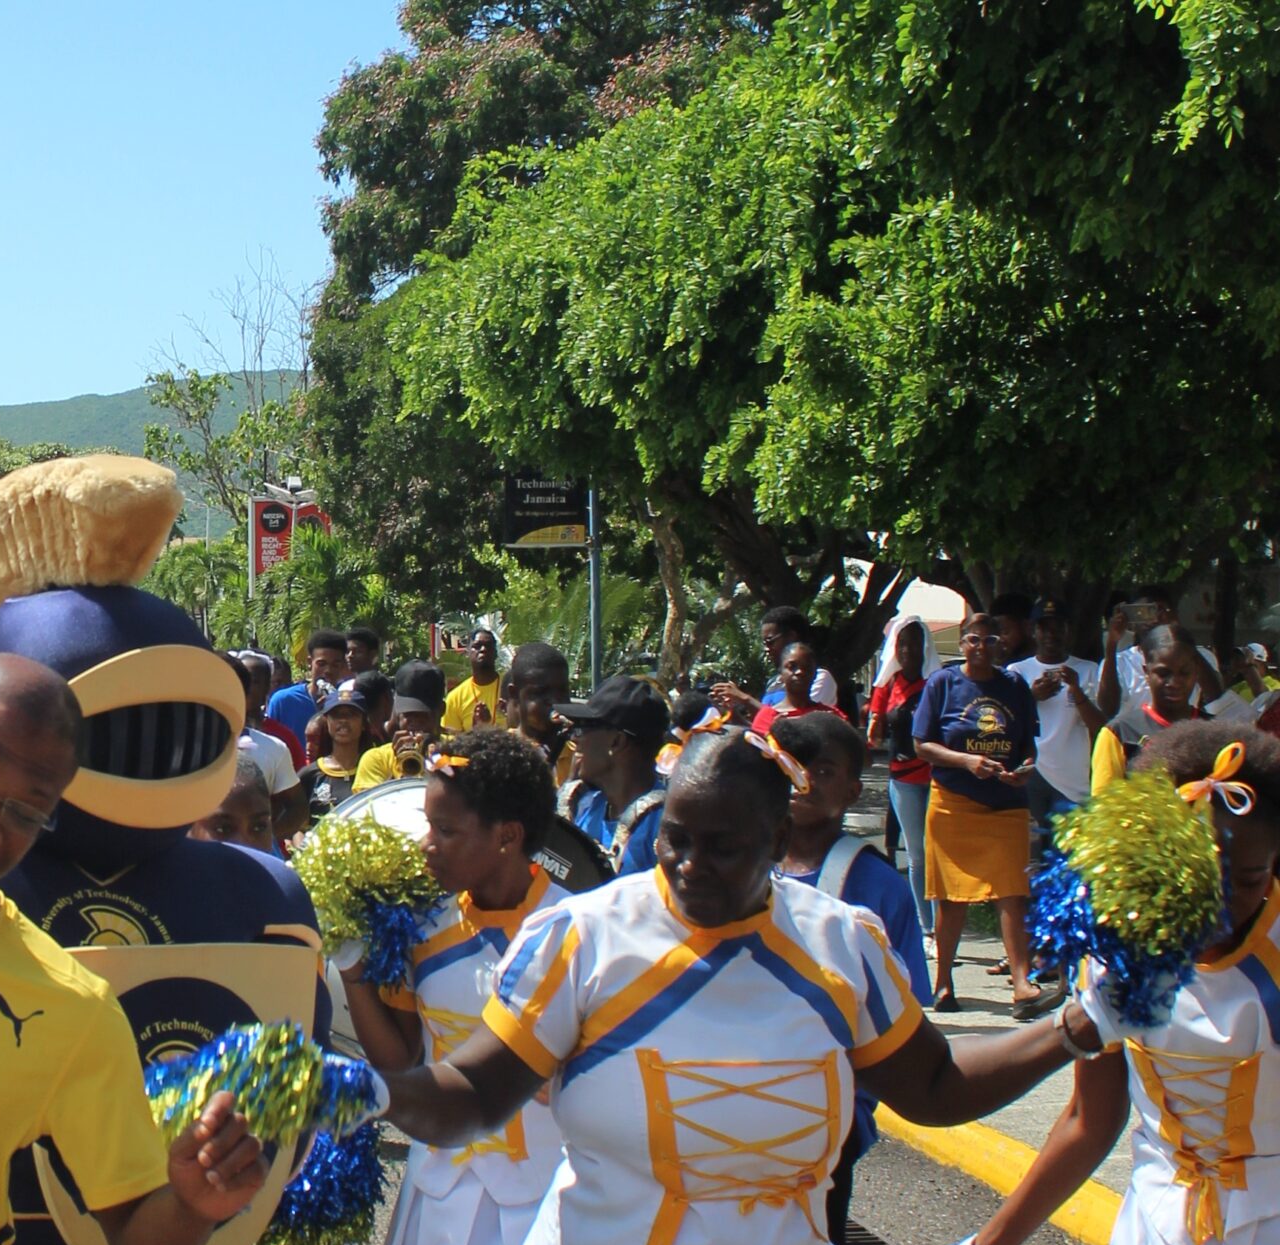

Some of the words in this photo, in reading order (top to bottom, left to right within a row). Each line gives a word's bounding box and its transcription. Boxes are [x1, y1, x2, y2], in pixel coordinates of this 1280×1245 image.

[523, 494, 567, 503] Jamaica
[966, 738, 1012, 751] Knights
[531, 851, 570, 880] EVAN
[41, 896, 73, 931] niversity
[73, 890, 84, 900] of
[140, 1026, 152, 1041] of
